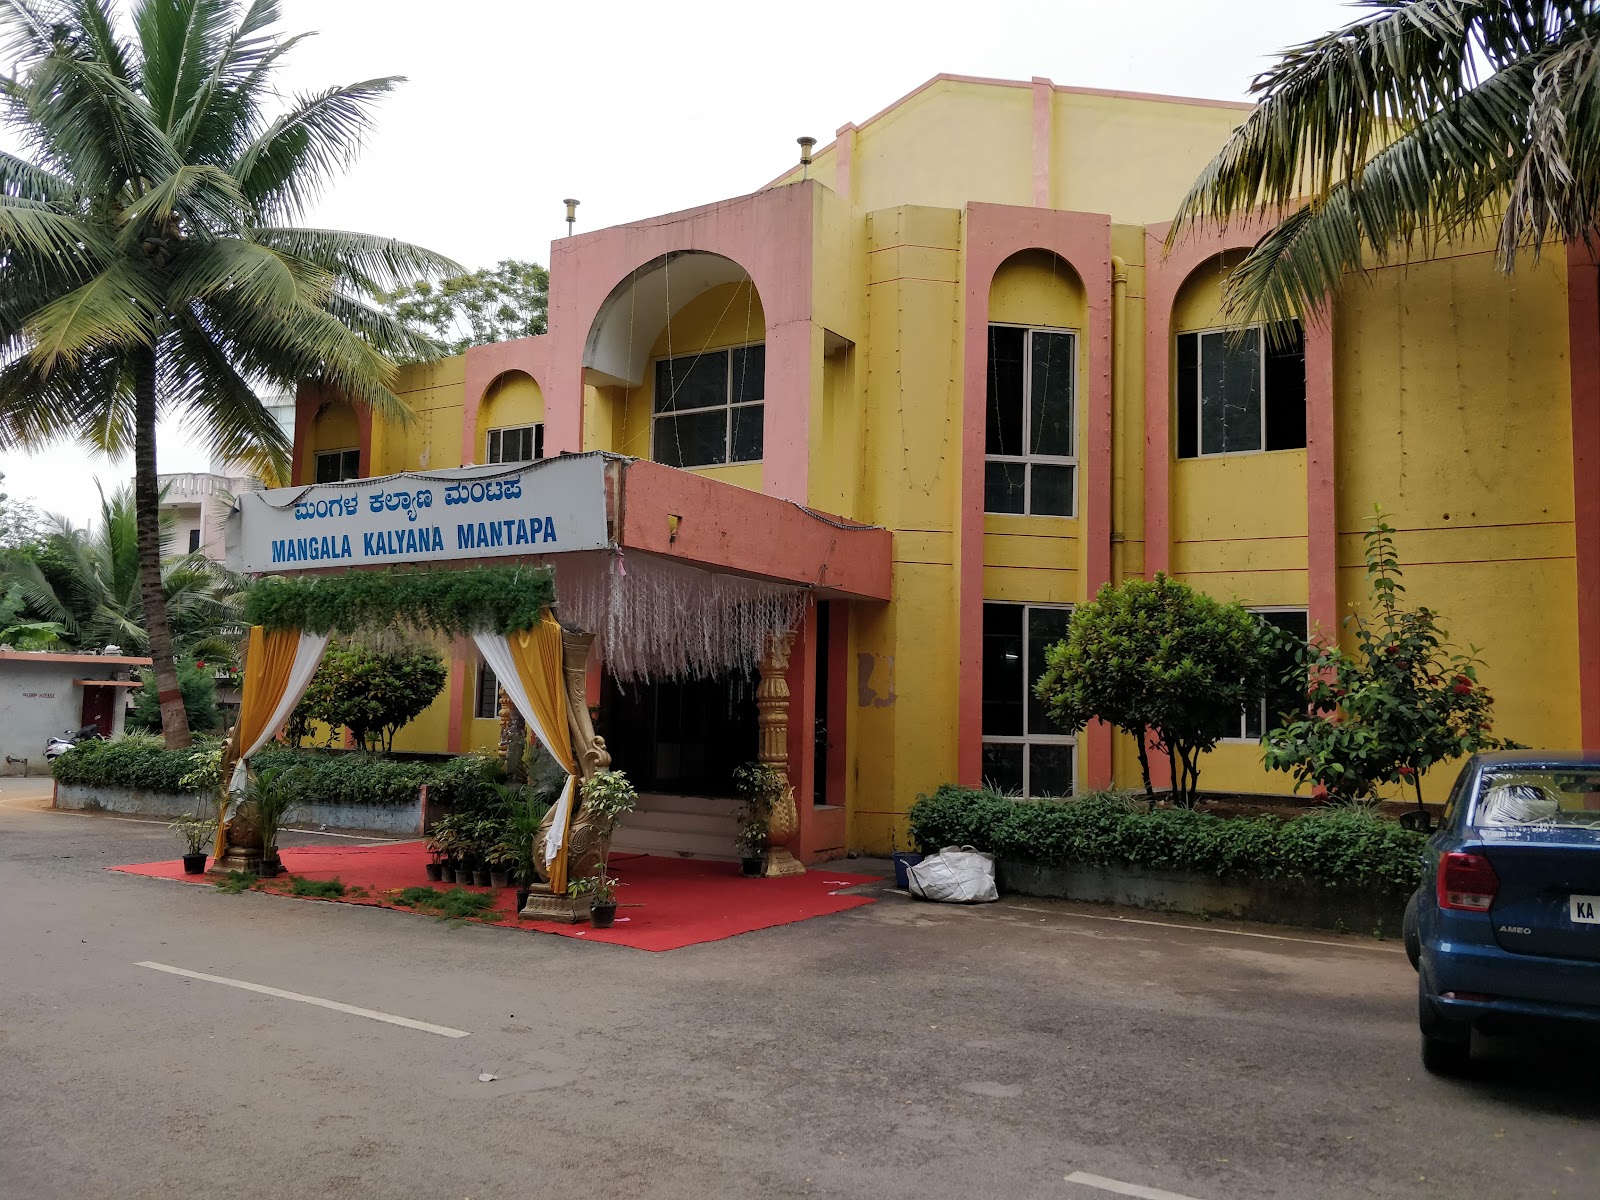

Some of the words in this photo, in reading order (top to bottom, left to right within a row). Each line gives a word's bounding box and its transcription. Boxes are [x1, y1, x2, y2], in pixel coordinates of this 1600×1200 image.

[295, 492, 359, 520] ಮಂಗಳ
[369, 488, 433, 522] ಕಲ್ಯಾಣ
[444, 475, 522, 505] ಮಂಟಪ
[271, 534, 352, 562] MANGALA
[363, 526, 444, 557] KALYANA
[457, 516, 557, 550] MANTAPA
[1576, 902, 1594, 919] KA
[1499, 926, 1532, 935] AMEO
